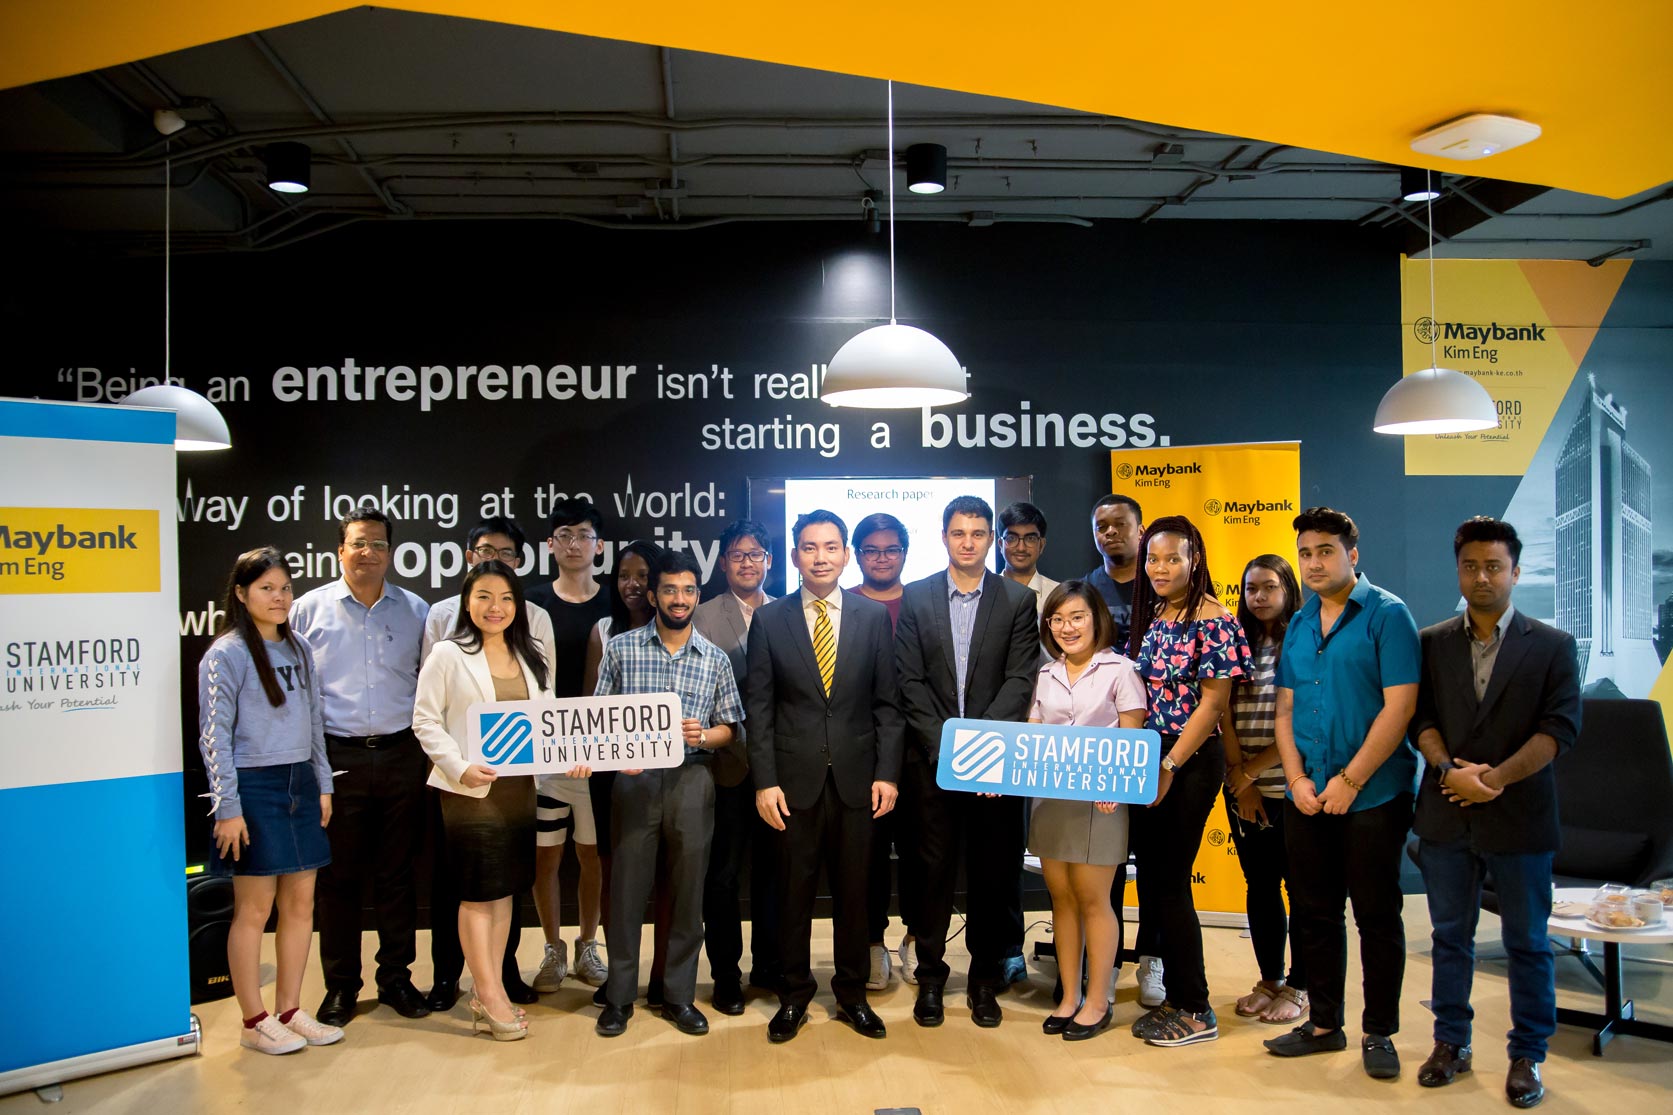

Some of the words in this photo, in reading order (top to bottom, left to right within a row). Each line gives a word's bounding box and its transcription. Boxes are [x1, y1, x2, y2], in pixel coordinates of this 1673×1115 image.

[1444, 322, 1546, 345] Maybank
[1443, 346, 1470, 359] Kim
[1473, 346, 1498, 363] Eng
[1458, 369, 1523, 377] maybank-ke.co.th
[206, 376, 250, 403] an
[272, 358, 637, 412] entrepreneur
[657, 364, 734, 400] isn’t
[754, 363, 839, 408] reall
[701, 418, 840, 458] starting
[870, 421, 891, 448] a
[922, 401, 1171, 448] business.
[1135, 463, 1202, 477] Maybank
[1135, 478, 1152, 487] Kim
[1154, 478, 1171, 488] Eng
[267, 485, 305, 522] of
[480, 487, 515, 519] at
[613, 472, 725, 518] world:
[847, 489, 899, 499] Research
[902, 490, 933, 502] paper
[1223, 500, 1293, 515] Maybank
[1223, 516, 1241, 524] Kim
[1243, 515, 1260, 525] Eng
[25, 558, 65, 581] Eng
[6, 638, 140, 669] STAMFORD
[6, 663, 141, 677] INTERNATIONAL
[7, 671, 141, 694] UNIVERSITY
[27, 699, 55, 711] Your
[60, 695, 119, 709] Potential
[541, 704, 672, 738] STAMFORD
[542, 732, 673, 746] INTERNATIONAL
[543, 740, 673, 764] UNIVERSITY
[1014, 733, 1150, 768] STAMFORD
[1013, 760, 1147, 777] INTERNATIONAL
[1011, 769, 1147, 794] UNIVERSITY
